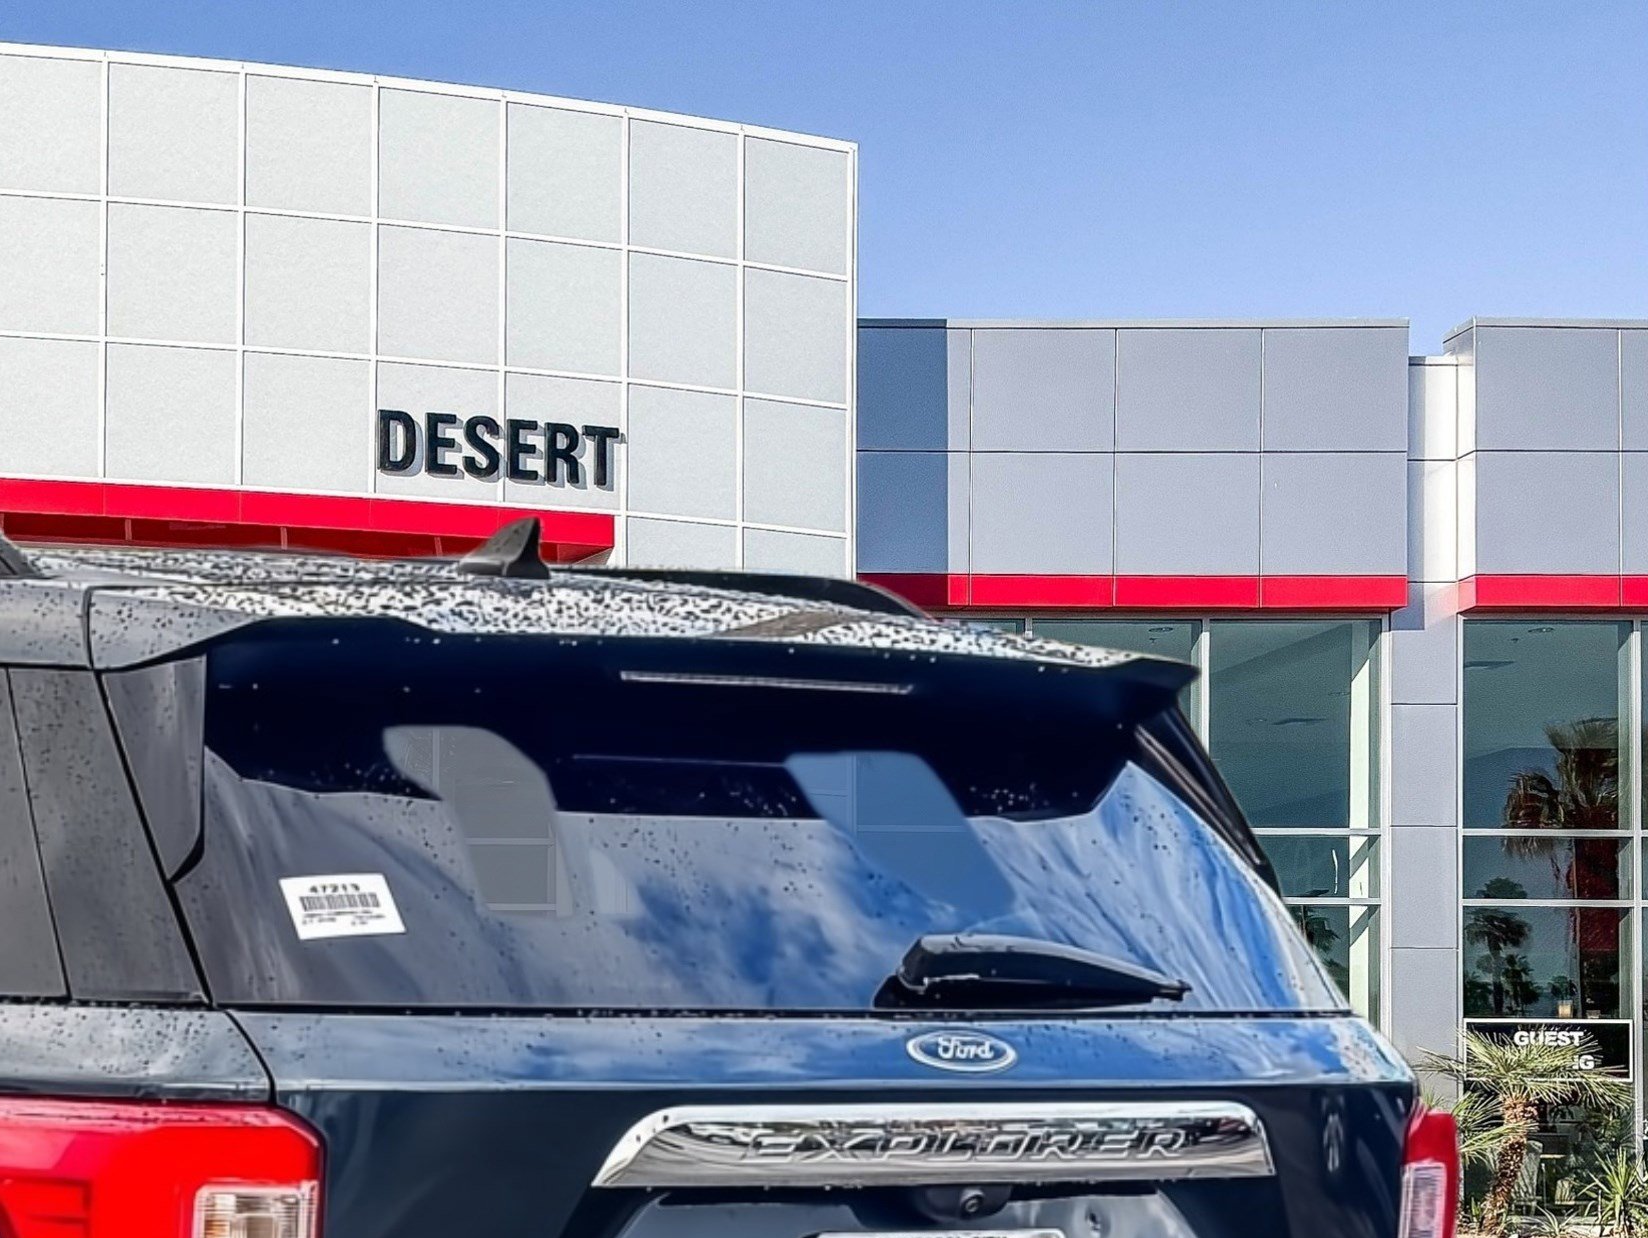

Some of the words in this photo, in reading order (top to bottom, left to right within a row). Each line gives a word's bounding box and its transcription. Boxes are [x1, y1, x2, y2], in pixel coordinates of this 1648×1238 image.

[377, 409, 620, 487] DESERT
[937, 1036, 994, 1059] Ford
[1513, 1031, 1585, 1046] GUEST
[741, 1129, 1187, 1162] EXPLORER
